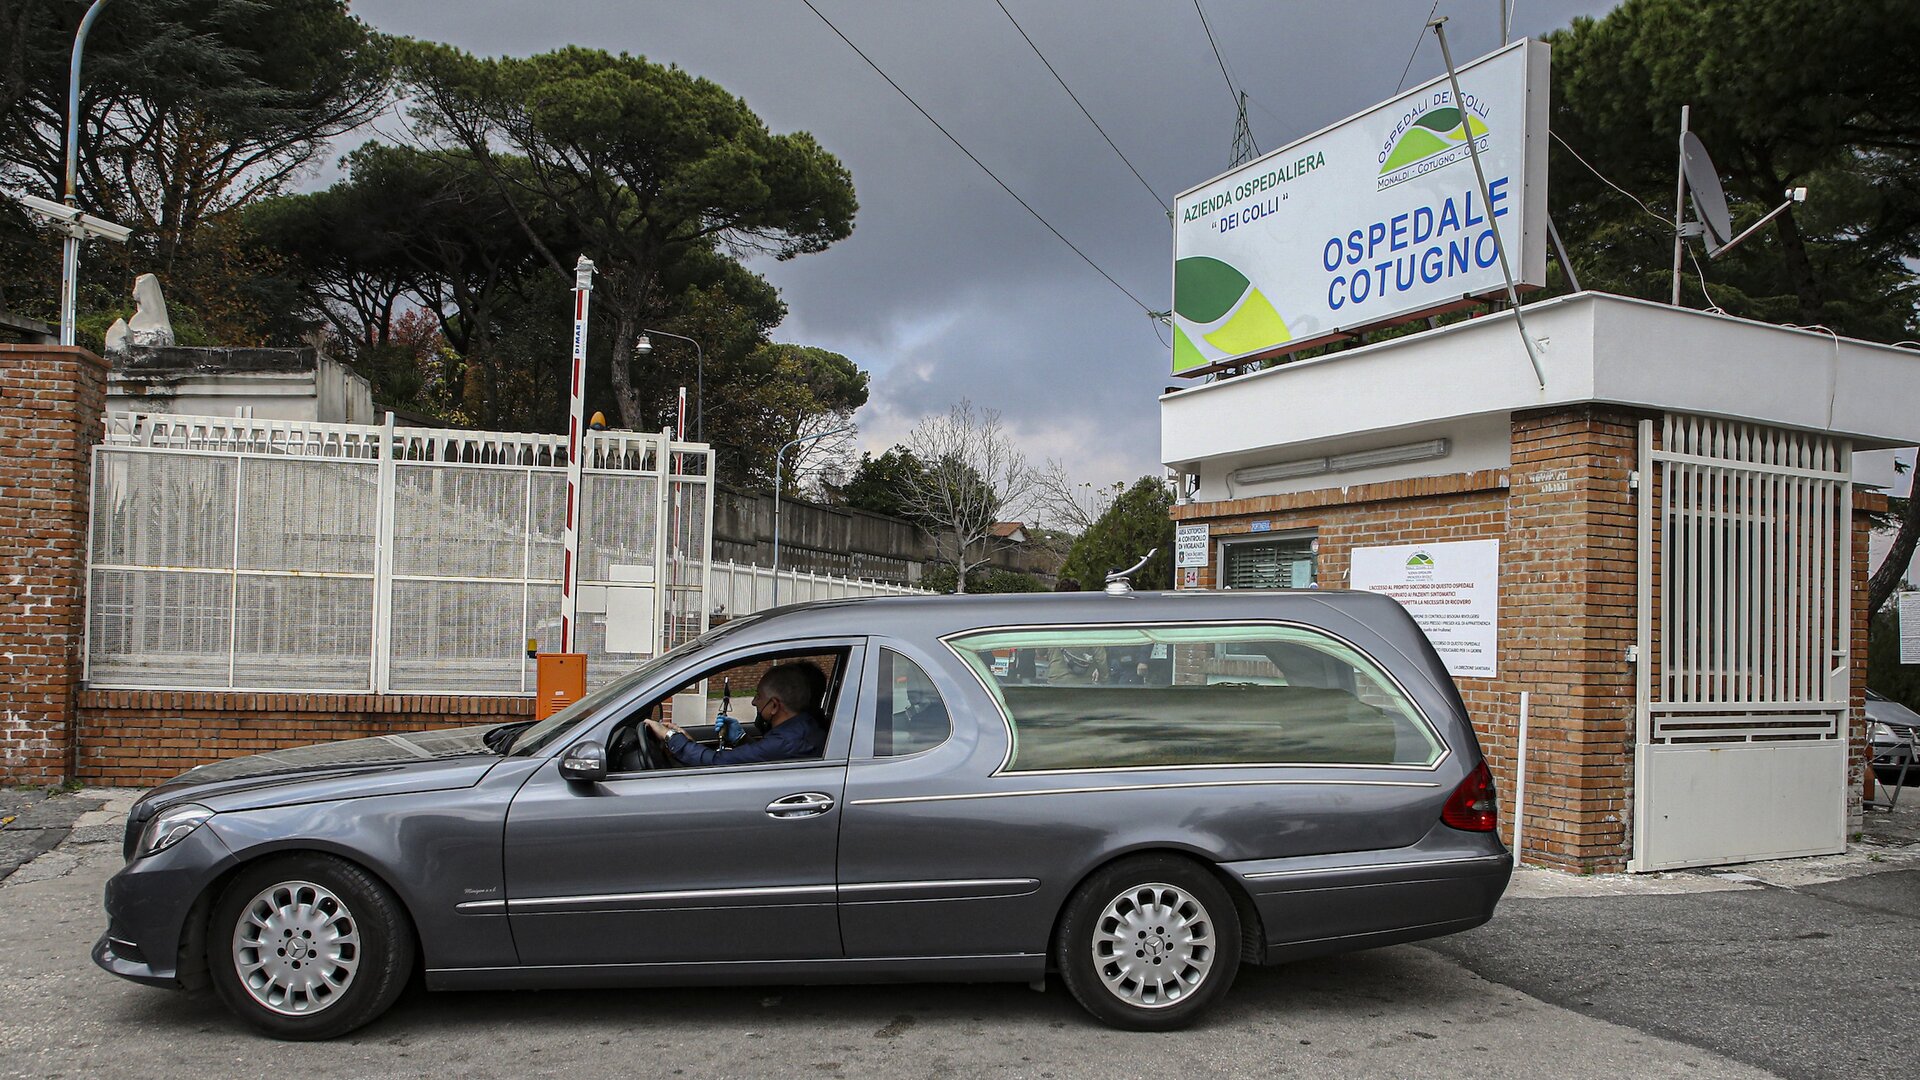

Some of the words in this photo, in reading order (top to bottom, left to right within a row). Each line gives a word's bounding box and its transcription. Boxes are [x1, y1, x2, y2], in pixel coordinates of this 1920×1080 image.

[1377, 98, 1429, 164] OSPEDALI
[1433, 91, 1453, 106] DEI
[1183, 190, 1233, 224] AZIENDA
[1235, 151, 1326, 202] OSPEDALIERA
[1377, 171, 1410, 189] MONALDI
[1417, 153, 1456, 174] COTUGNO
[1323, 176, 1509, 273] OSPEDALE
[1328, 228, 1500, 311] COTUGNO
[1186, 571, 1196, 583] 54
